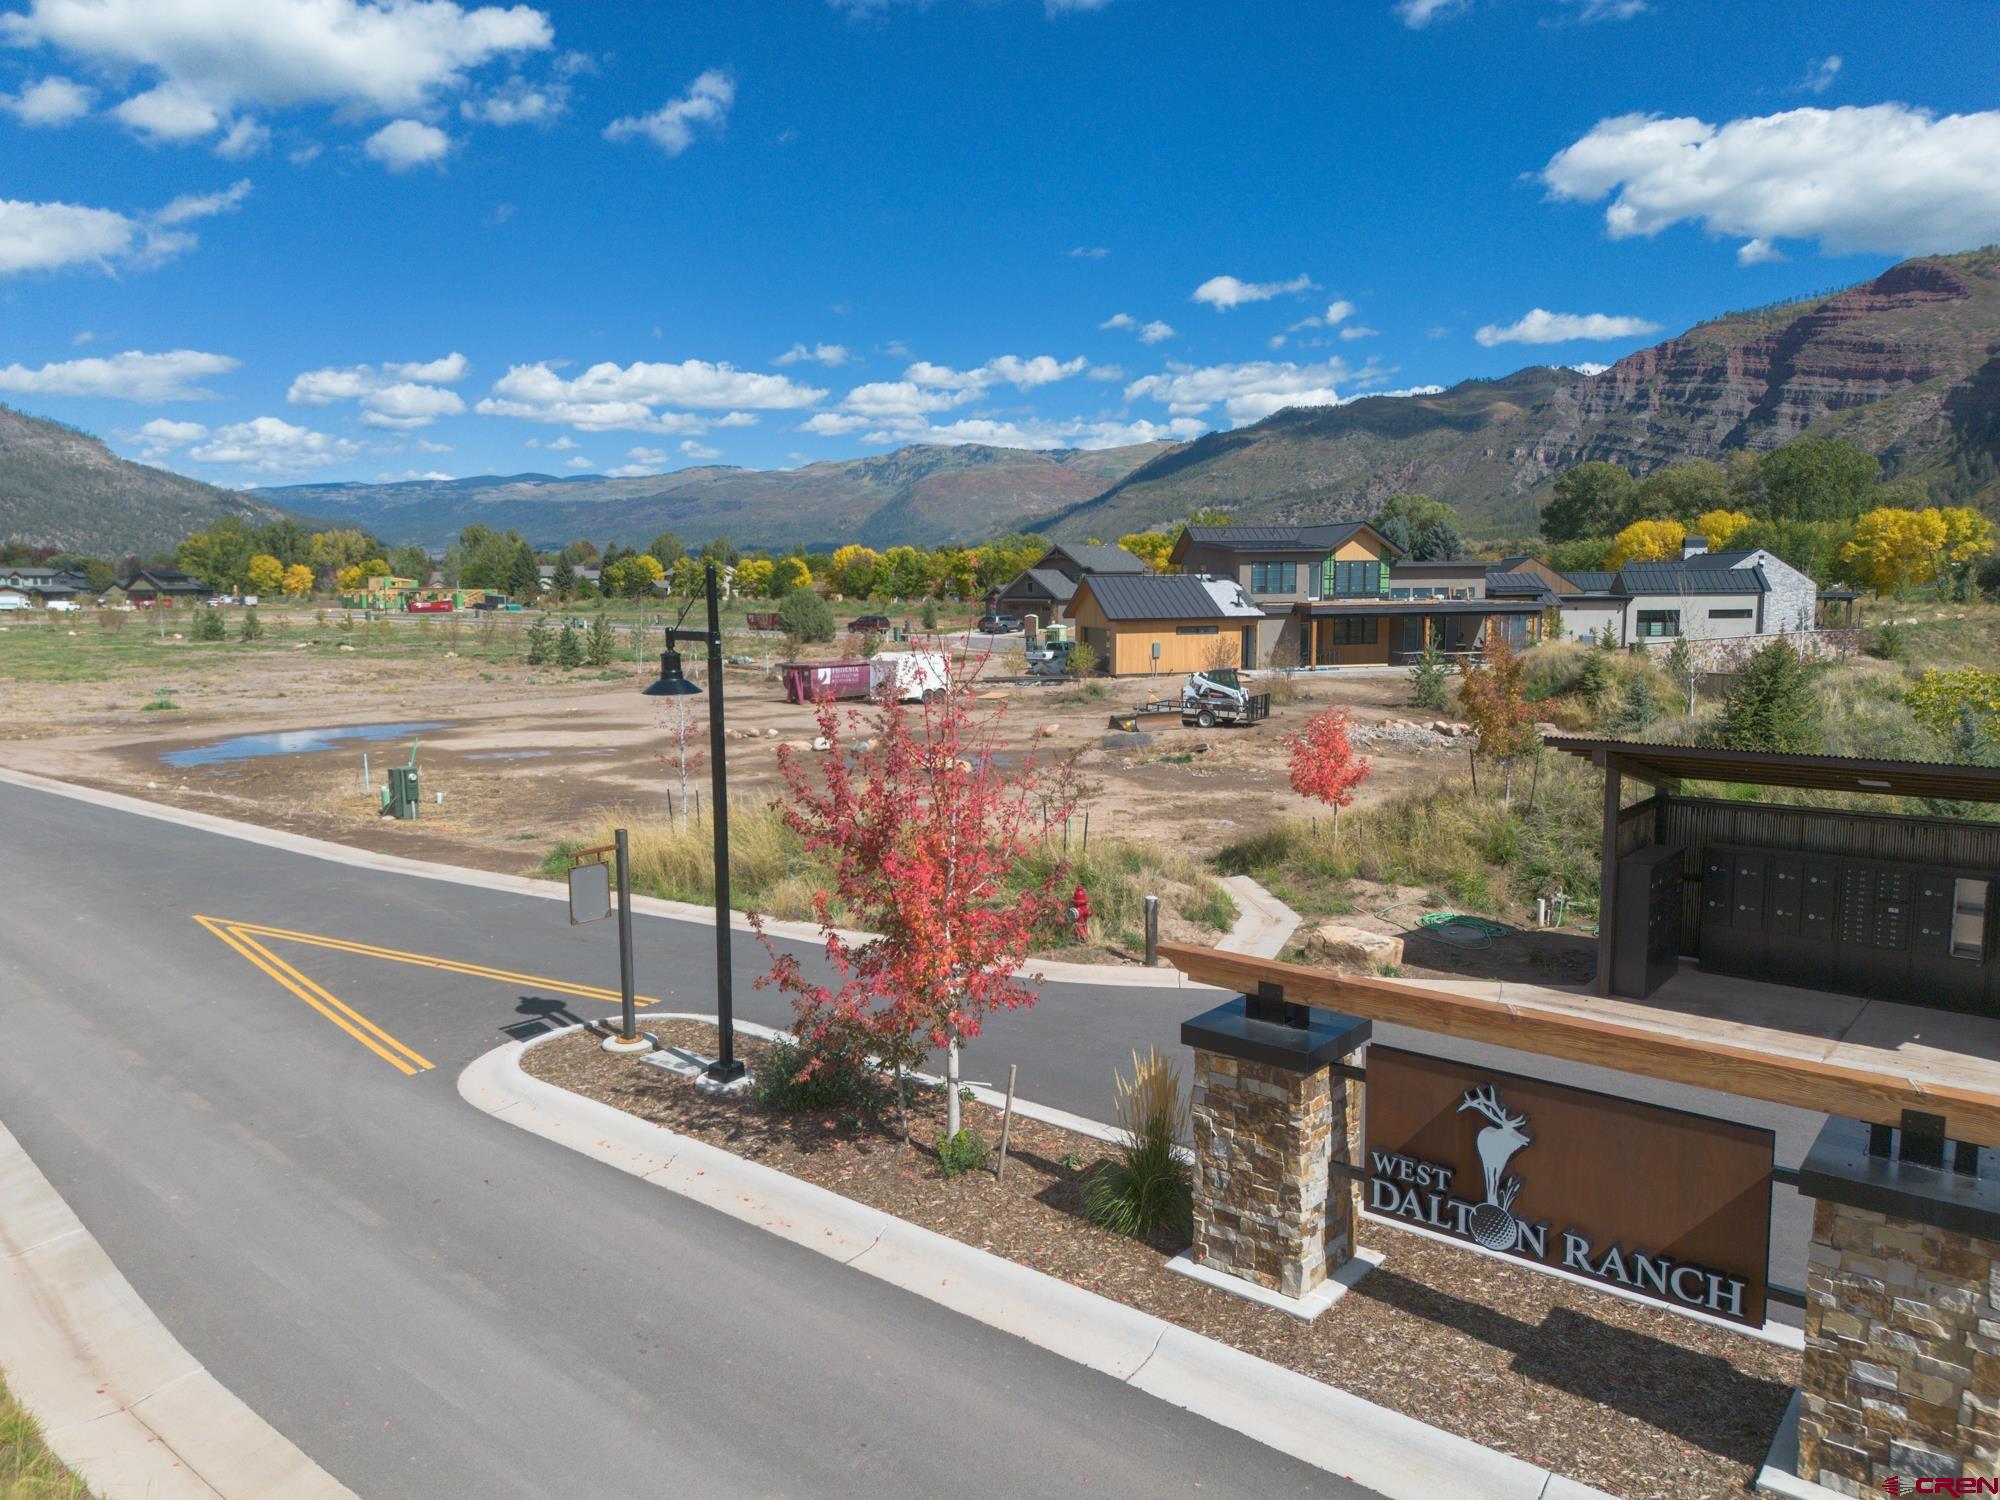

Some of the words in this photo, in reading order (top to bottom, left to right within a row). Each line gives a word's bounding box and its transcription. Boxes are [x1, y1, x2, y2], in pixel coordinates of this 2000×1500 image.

[1372, 1152, 1452, 1191] WEST
[1370, 1177, 1549, 1259] DALTON
[1561, 1232, 1746, 1318] RANCH
